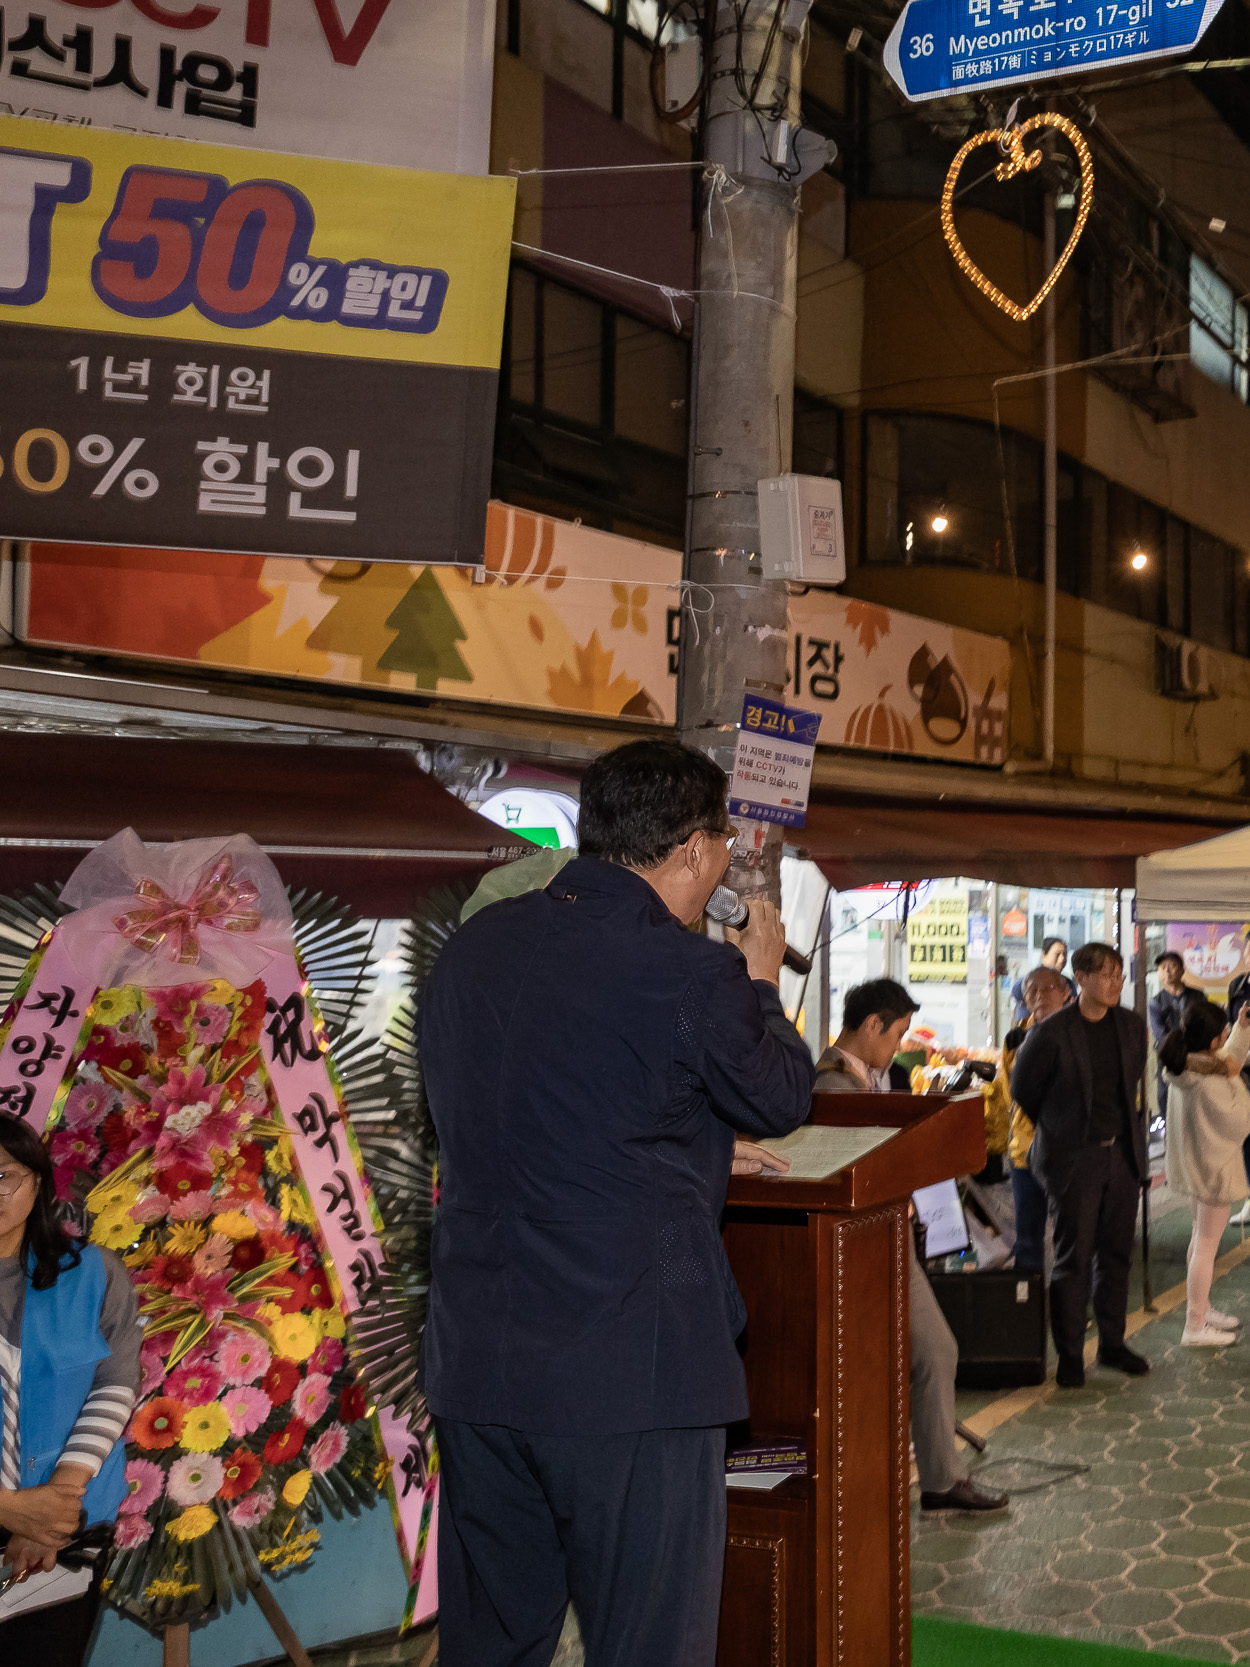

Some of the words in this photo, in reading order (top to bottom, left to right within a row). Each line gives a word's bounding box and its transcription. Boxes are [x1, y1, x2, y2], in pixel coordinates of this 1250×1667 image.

[949, 14, 1086, 57] Myeonmok-ro
[1095, 0, 1153, 27] 17-gil
[909, 33, 934, 59] 36
[1029, 30, 1150, 64] ミョンモクロ17ギル
[0, 6, 260, 128] 선사업
[339, 264, 433, 321] 할인
[67, 354, 151, 402] 1년
[171, 360, 272, 413] 회원
[0, 426, 160, 501] 0%
[195, 435, 361, 522] 할인
[745, 705, 786, 733] 경고!
[738, 756, 754, 768] 위해
[755, 760, 786, 775] CCTV가
[740, 744, 748, 754] 이
[750, 745, 773, 759] 지역은
[774, 751, 811, 768] 범죄예방을
[736, 769, 767, 785] 작동되고
